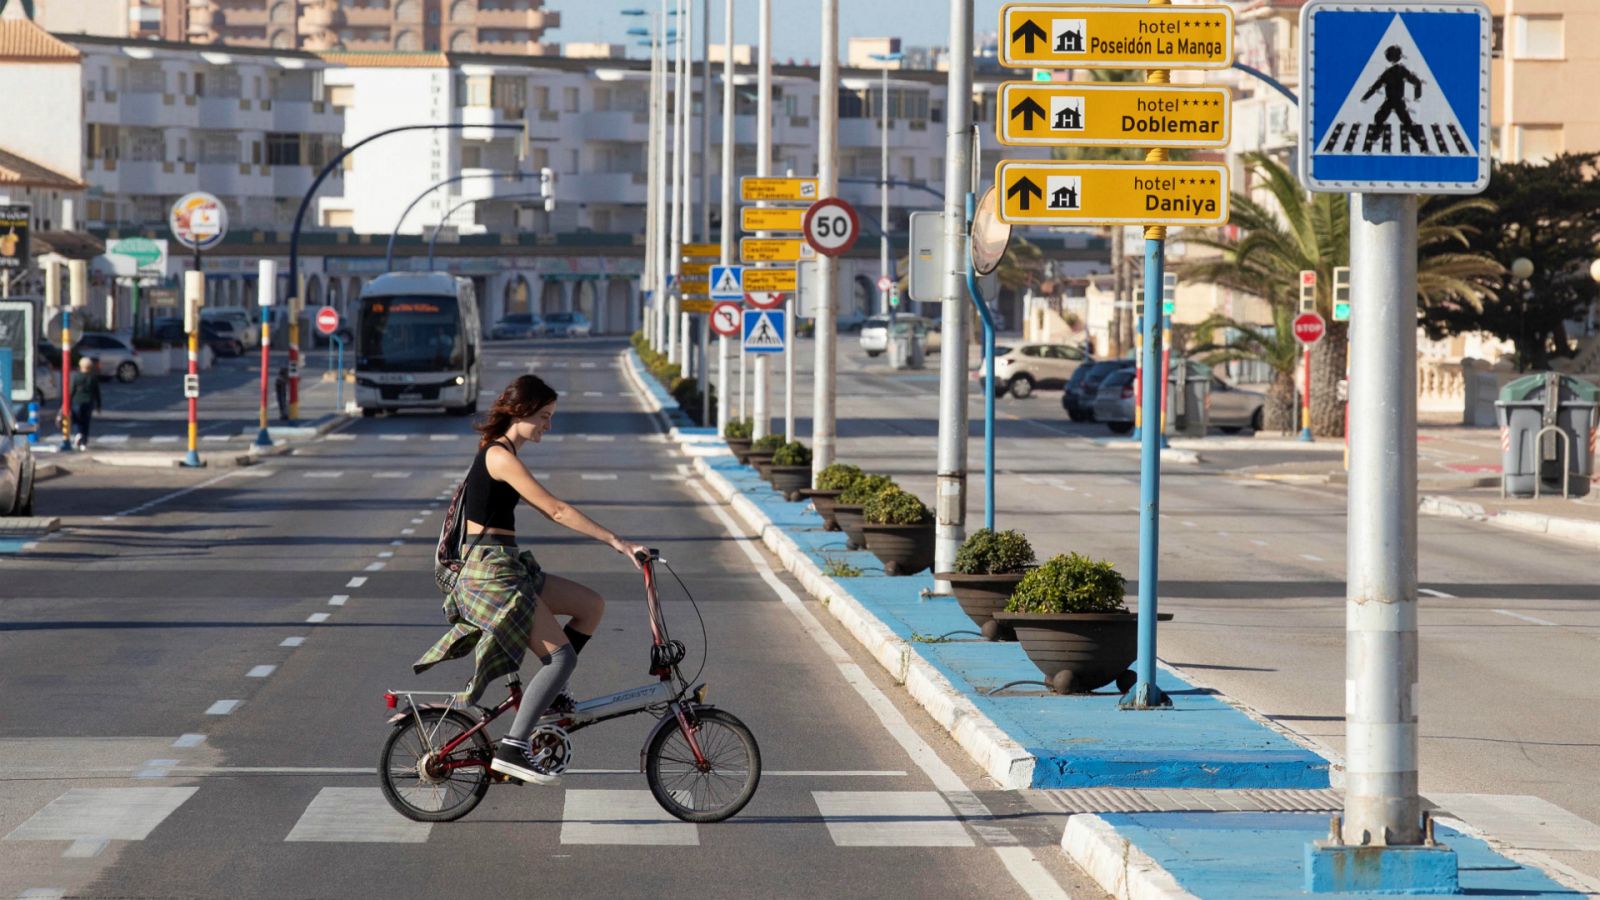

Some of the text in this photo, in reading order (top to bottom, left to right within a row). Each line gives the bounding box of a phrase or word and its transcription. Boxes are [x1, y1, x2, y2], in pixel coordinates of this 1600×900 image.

[1139, 19, 1181, 34] hotel
[1090, 36, 1222, 58] Poseidón La Manga
[1137, 97, 1179, 112] hotel
[1121, 115, 1220, 133] Doblemar
[1134, 176, 1176, 191] hotel
[1145, 194, 1216, 215] Daniya
[817, 216, 848, 238] 50
[1296, 323, 1322, 333] STOP
